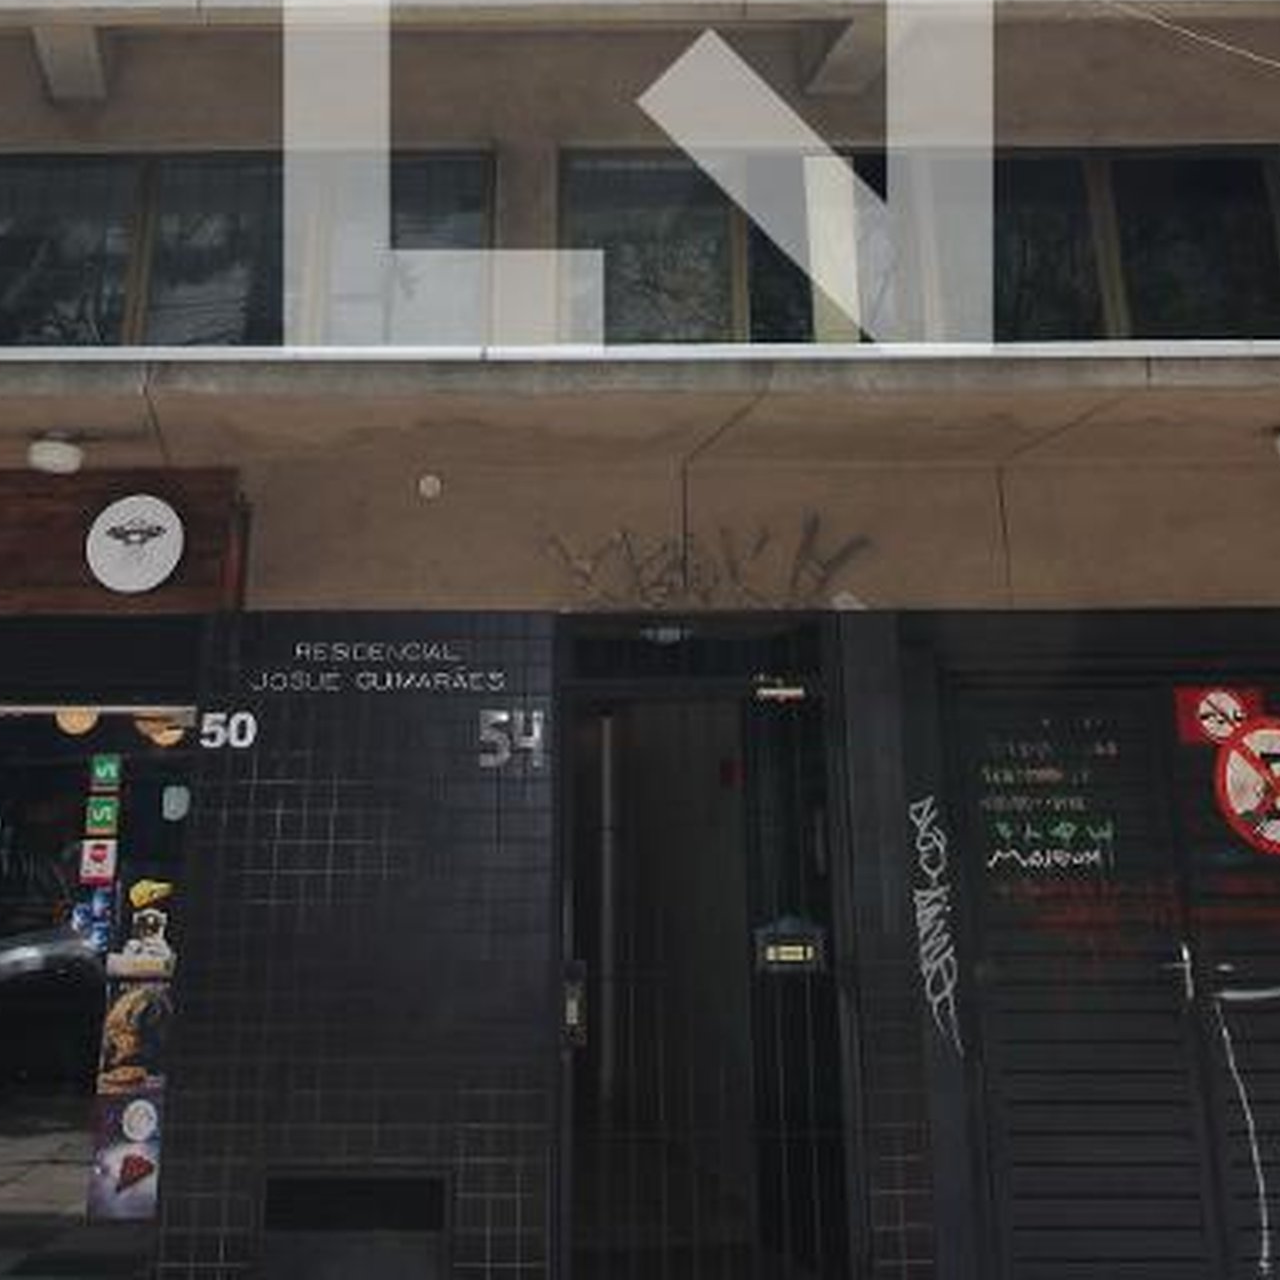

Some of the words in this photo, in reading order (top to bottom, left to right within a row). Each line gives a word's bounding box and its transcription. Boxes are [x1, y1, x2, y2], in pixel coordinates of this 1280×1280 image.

[293, 641, 461, 662] RESIDENCIAL
[356, 665, 506, 692] GUIMARÃES
[200, 712, 258, 749] 50
[479, 709, 545, 768] 54
